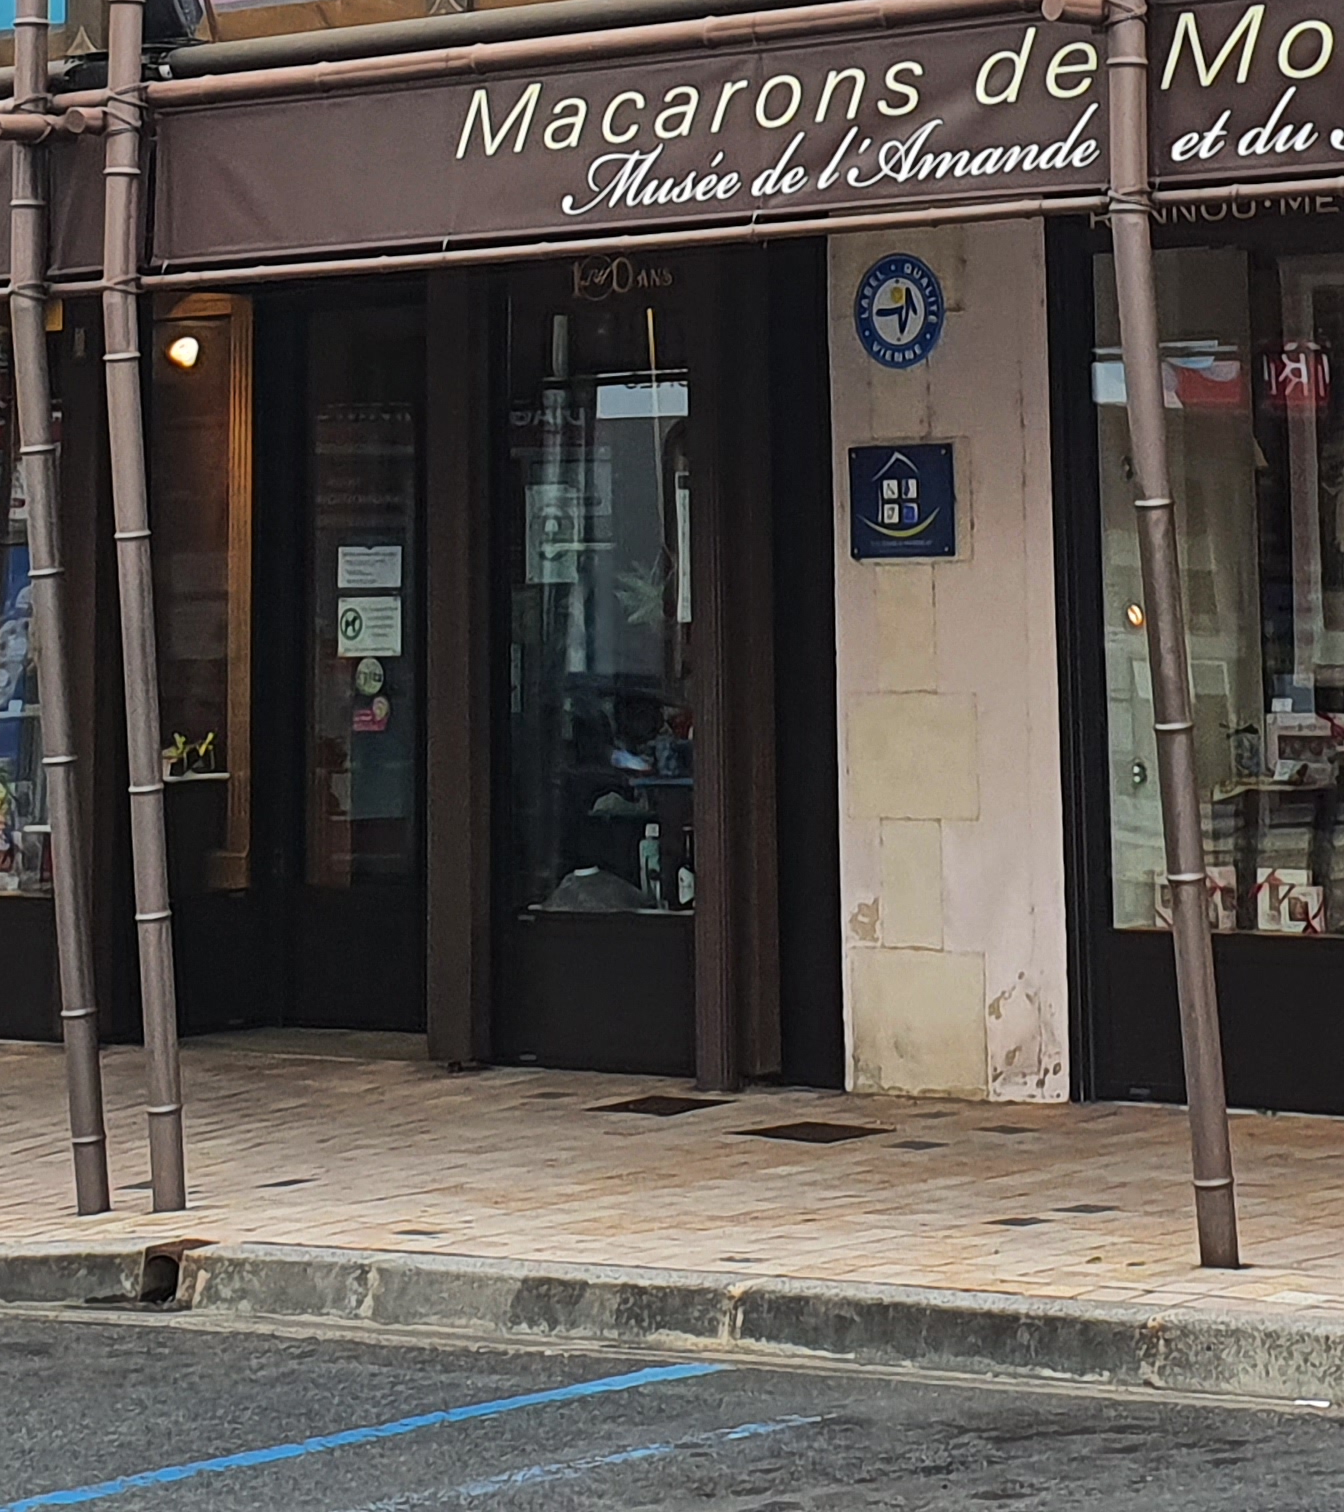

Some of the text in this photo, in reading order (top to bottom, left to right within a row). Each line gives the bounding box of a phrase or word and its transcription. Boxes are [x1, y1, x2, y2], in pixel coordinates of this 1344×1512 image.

[456, 61, 924, 159] Macarons
[975, 26, 1098, 105] de
[562, 143, 741, 215] Musée
[751, 132, 808, 197] de
[817, 97, 1100, 189] l'Amande
[1171, 109, 1231, 162] et
[1237, 86, 1319, 156] du
